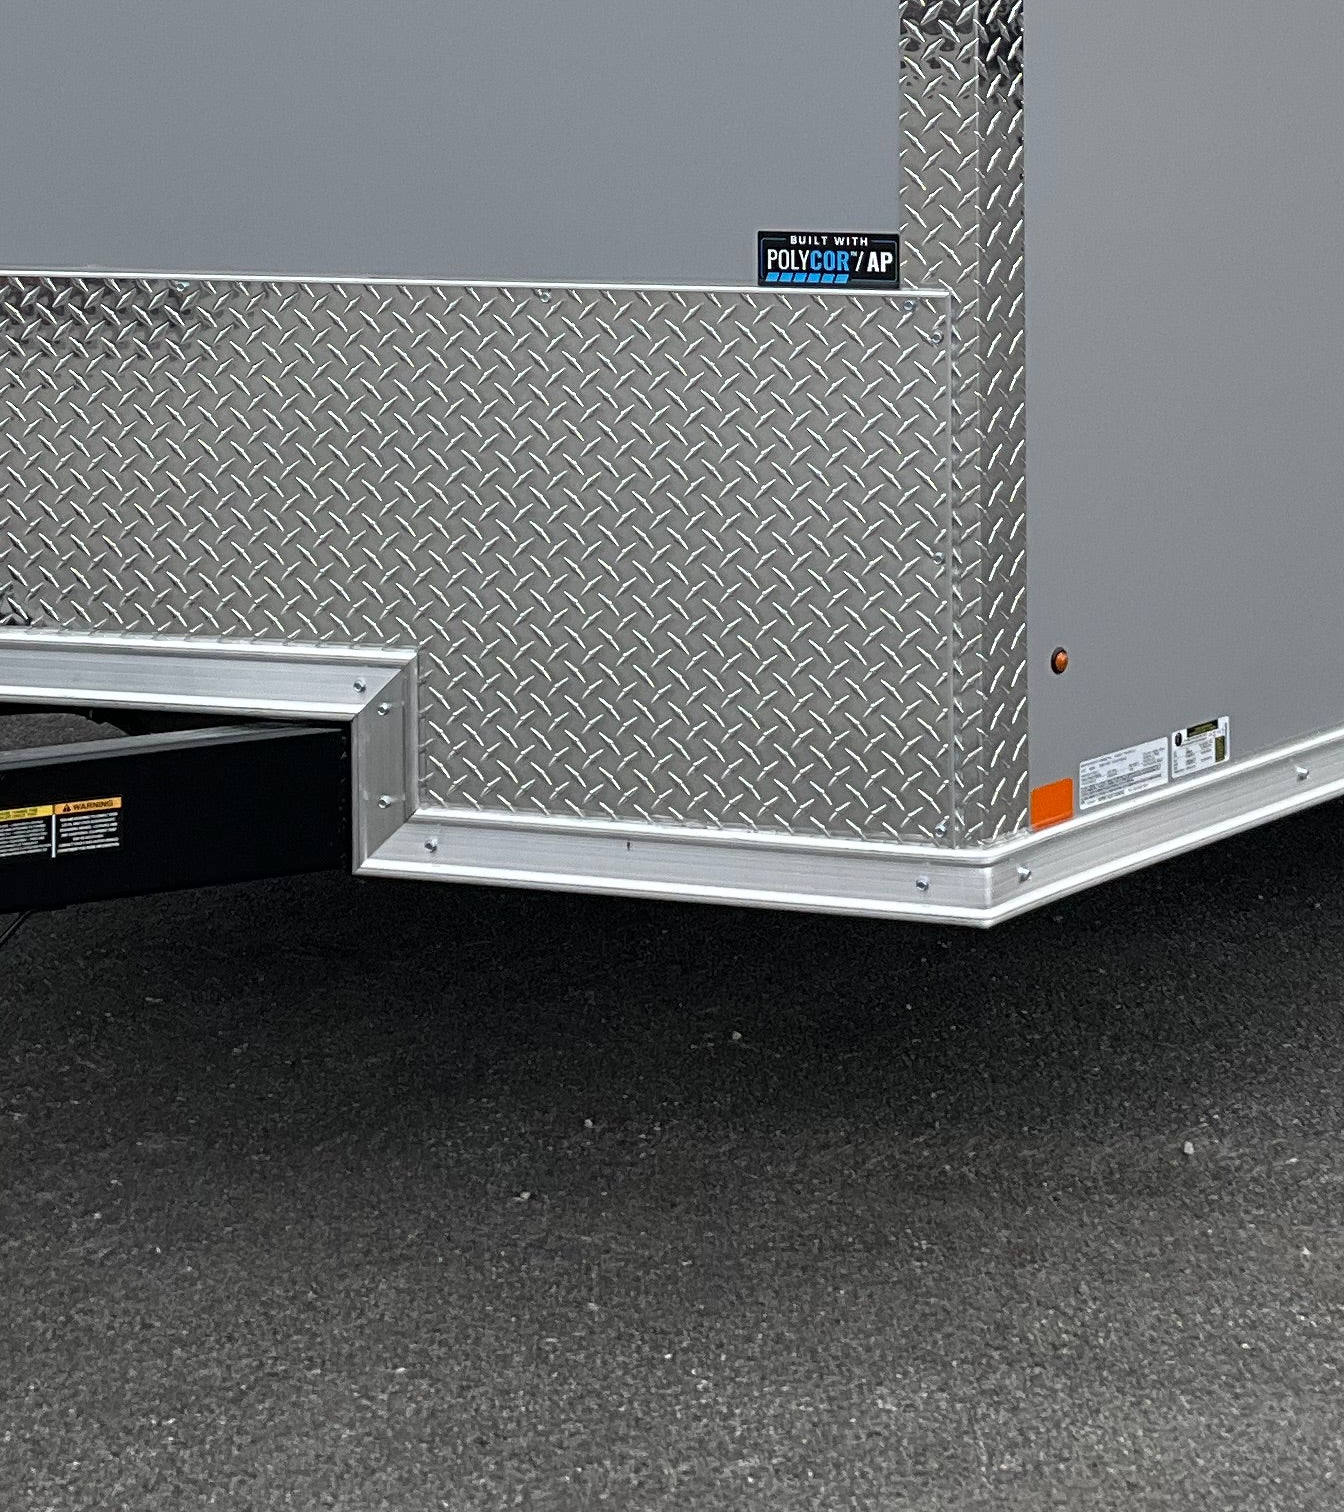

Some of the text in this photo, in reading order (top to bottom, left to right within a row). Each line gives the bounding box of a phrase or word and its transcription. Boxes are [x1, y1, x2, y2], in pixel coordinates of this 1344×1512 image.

[789, 235, 868, 247] BUILT WITH
[72, 799, 114, 811] WARNING
